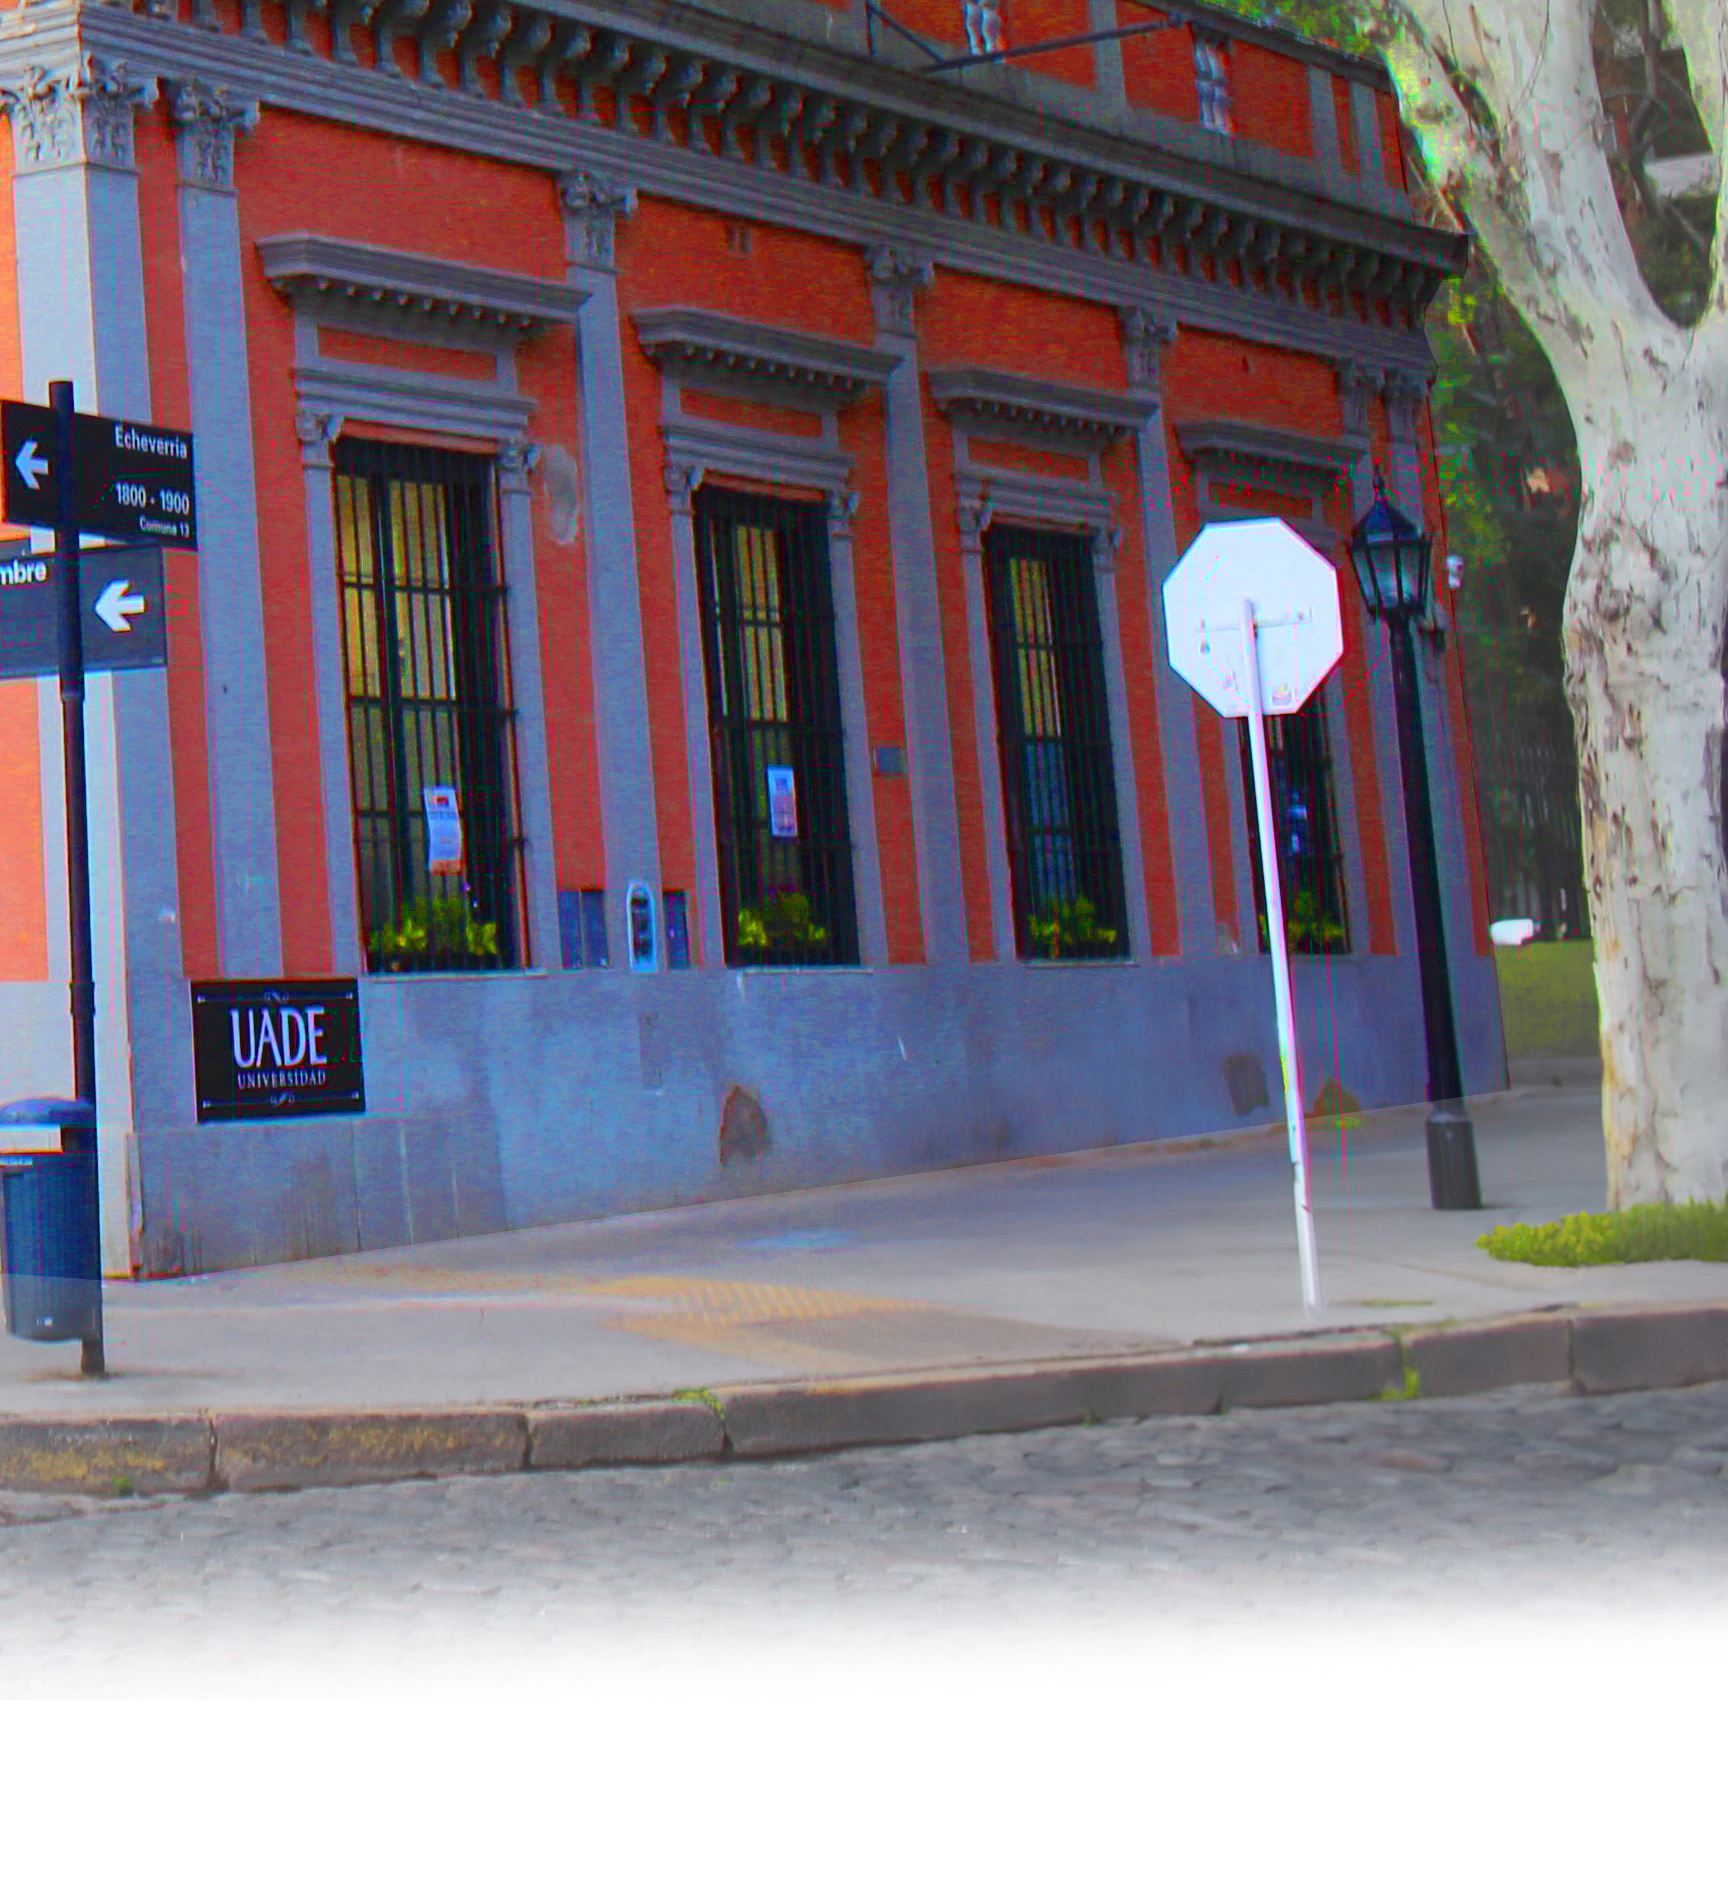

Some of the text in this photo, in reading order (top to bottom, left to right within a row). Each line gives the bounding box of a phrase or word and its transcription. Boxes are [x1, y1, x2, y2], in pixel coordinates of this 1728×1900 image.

[116, 482, 146, 508] 1800
[160, 488, 190, 515] 1900
[139, 514, 190, 538] Comuna 13
[229, 1005, 327, 1069] UADE
[237, 1070, 326, 1090] UNIVERSIDAD
